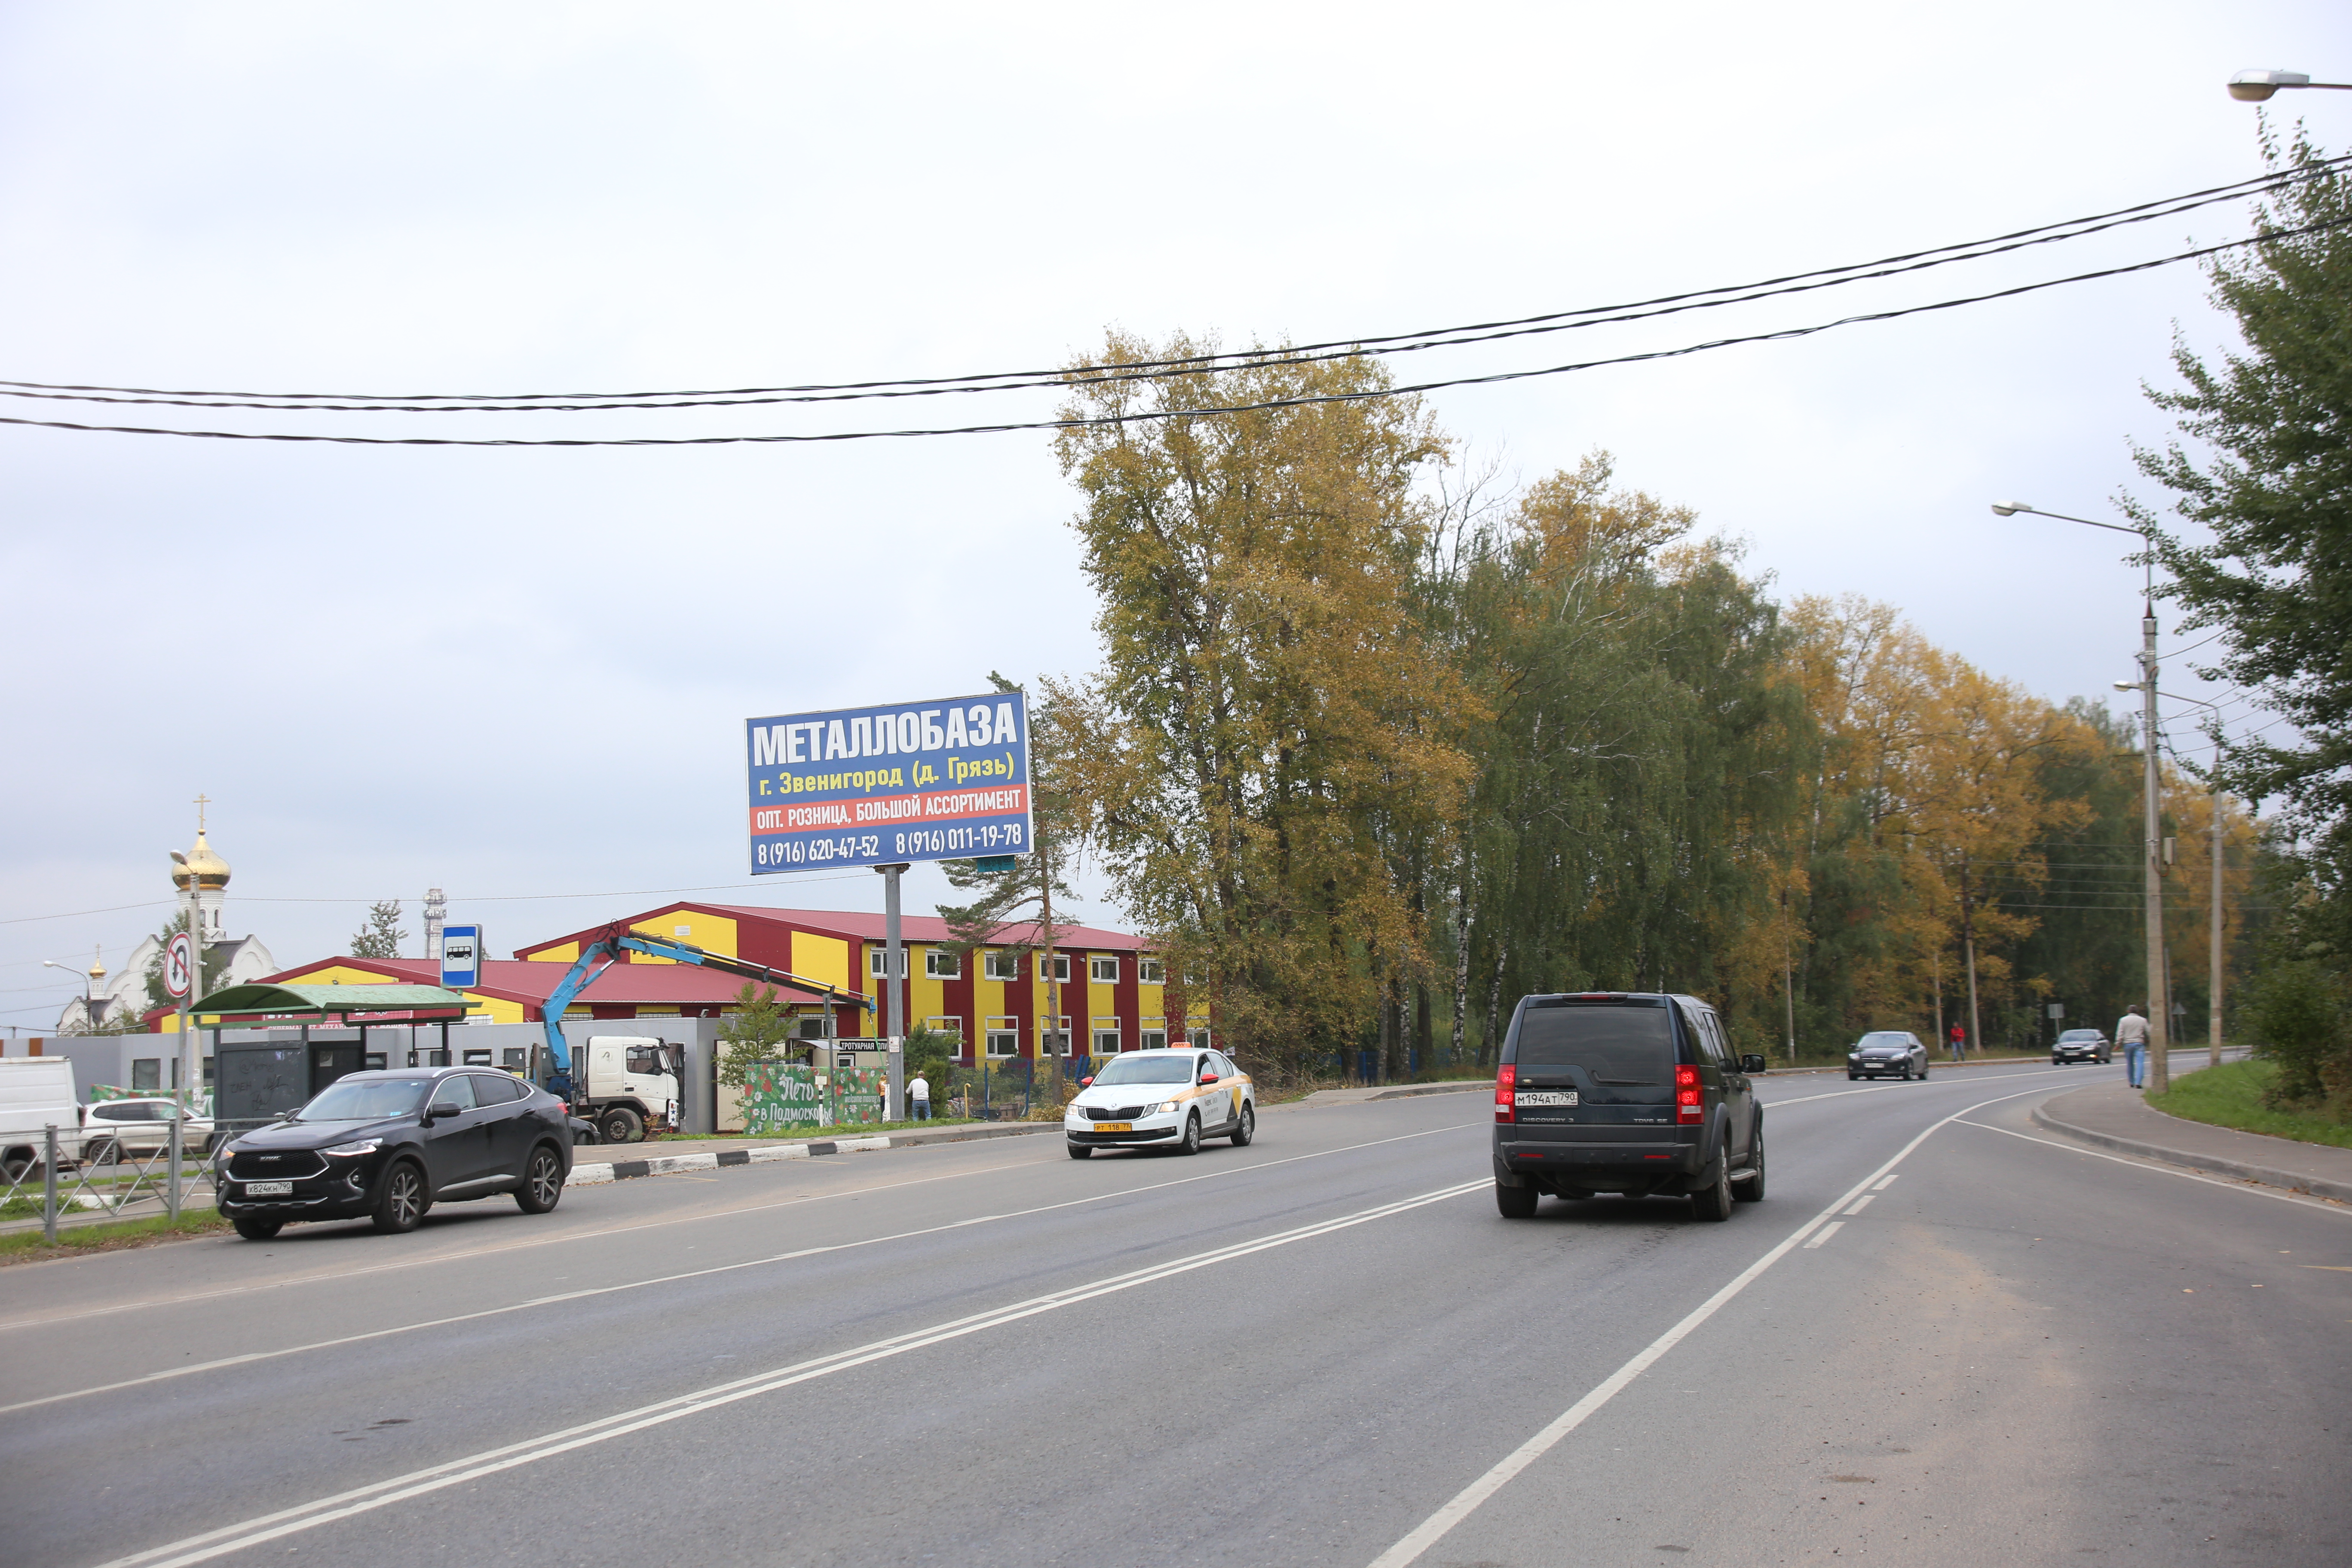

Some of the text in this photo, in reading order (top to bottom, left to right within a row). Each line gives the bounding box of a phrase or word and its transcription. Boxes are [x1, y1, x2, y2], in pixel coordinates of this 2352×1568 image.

[753, 702, 1017, 766] МЕТАЛЛОБАЗА
[760, 752, 1014, 796] г. Звенигород (д. Грязь)
[757, 789, 1021, 830] ОПТ. РОЗНИЦА, БОЛЬШОЙ АССОРТИМЕНТ
[758, 835, 879, 866] 8 (916) 620-47-52
[896, 823, 1022, 855] 8 (916) 011-19-78
[781, 1076, 814, 1101] Лето
[761, 1108, 767, 1121] в
